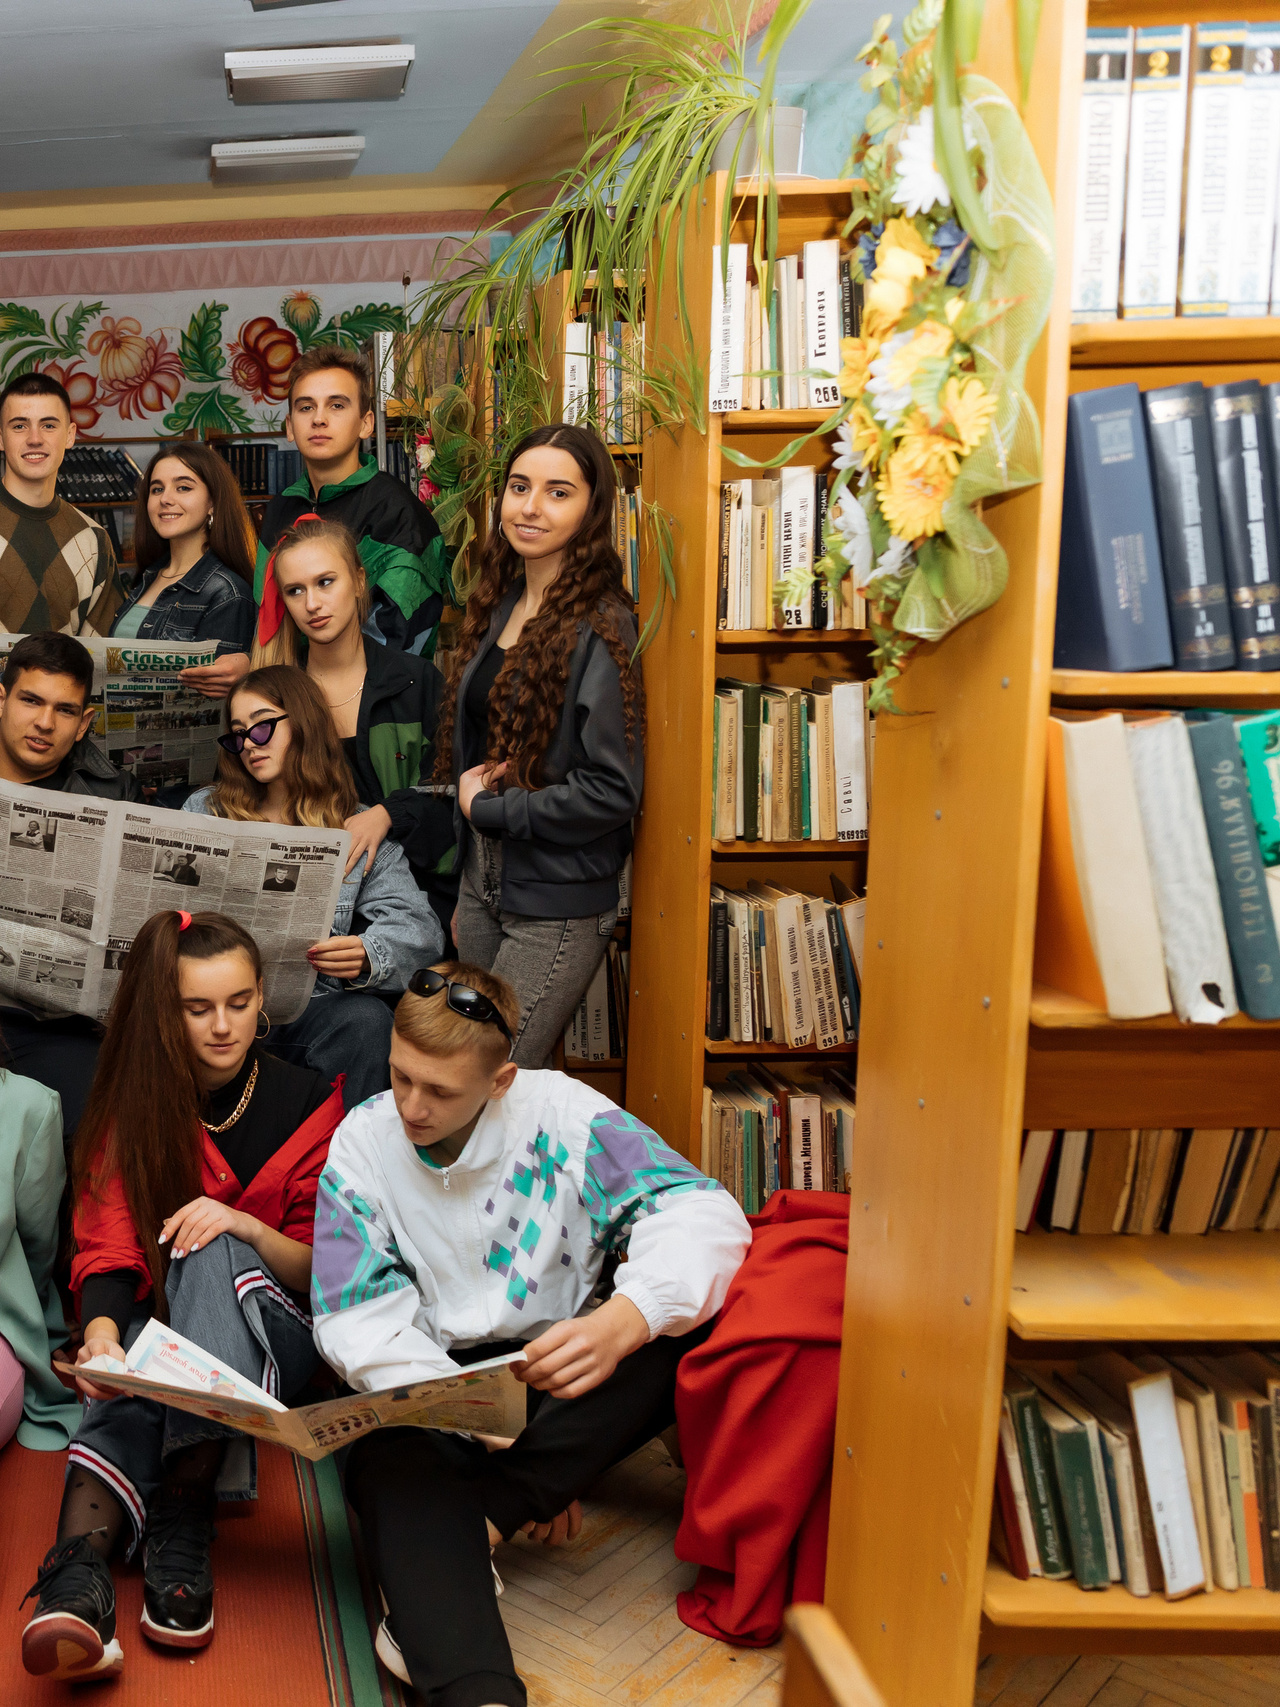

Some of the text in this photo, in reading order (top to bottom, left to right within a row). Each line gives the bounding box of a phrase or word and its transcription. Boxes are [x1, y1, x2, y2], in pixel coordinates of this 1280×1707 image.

[1097, 54, 1110, 79] 1
[1148, 50, 1170, 78] 2
[1210, 45, 1232, 72] 2
[1253, 47, 1274, 74] 3
[13, 802, 43, 816] Небезпека
[193, 843, 211, 855] ринку
[270, 843, 289, 852] Шість
[283, 852, 324, 861] для України
[160, 1349, 208, 1384] Draw yourself
[1040, 1507, 1052, 1527] для
